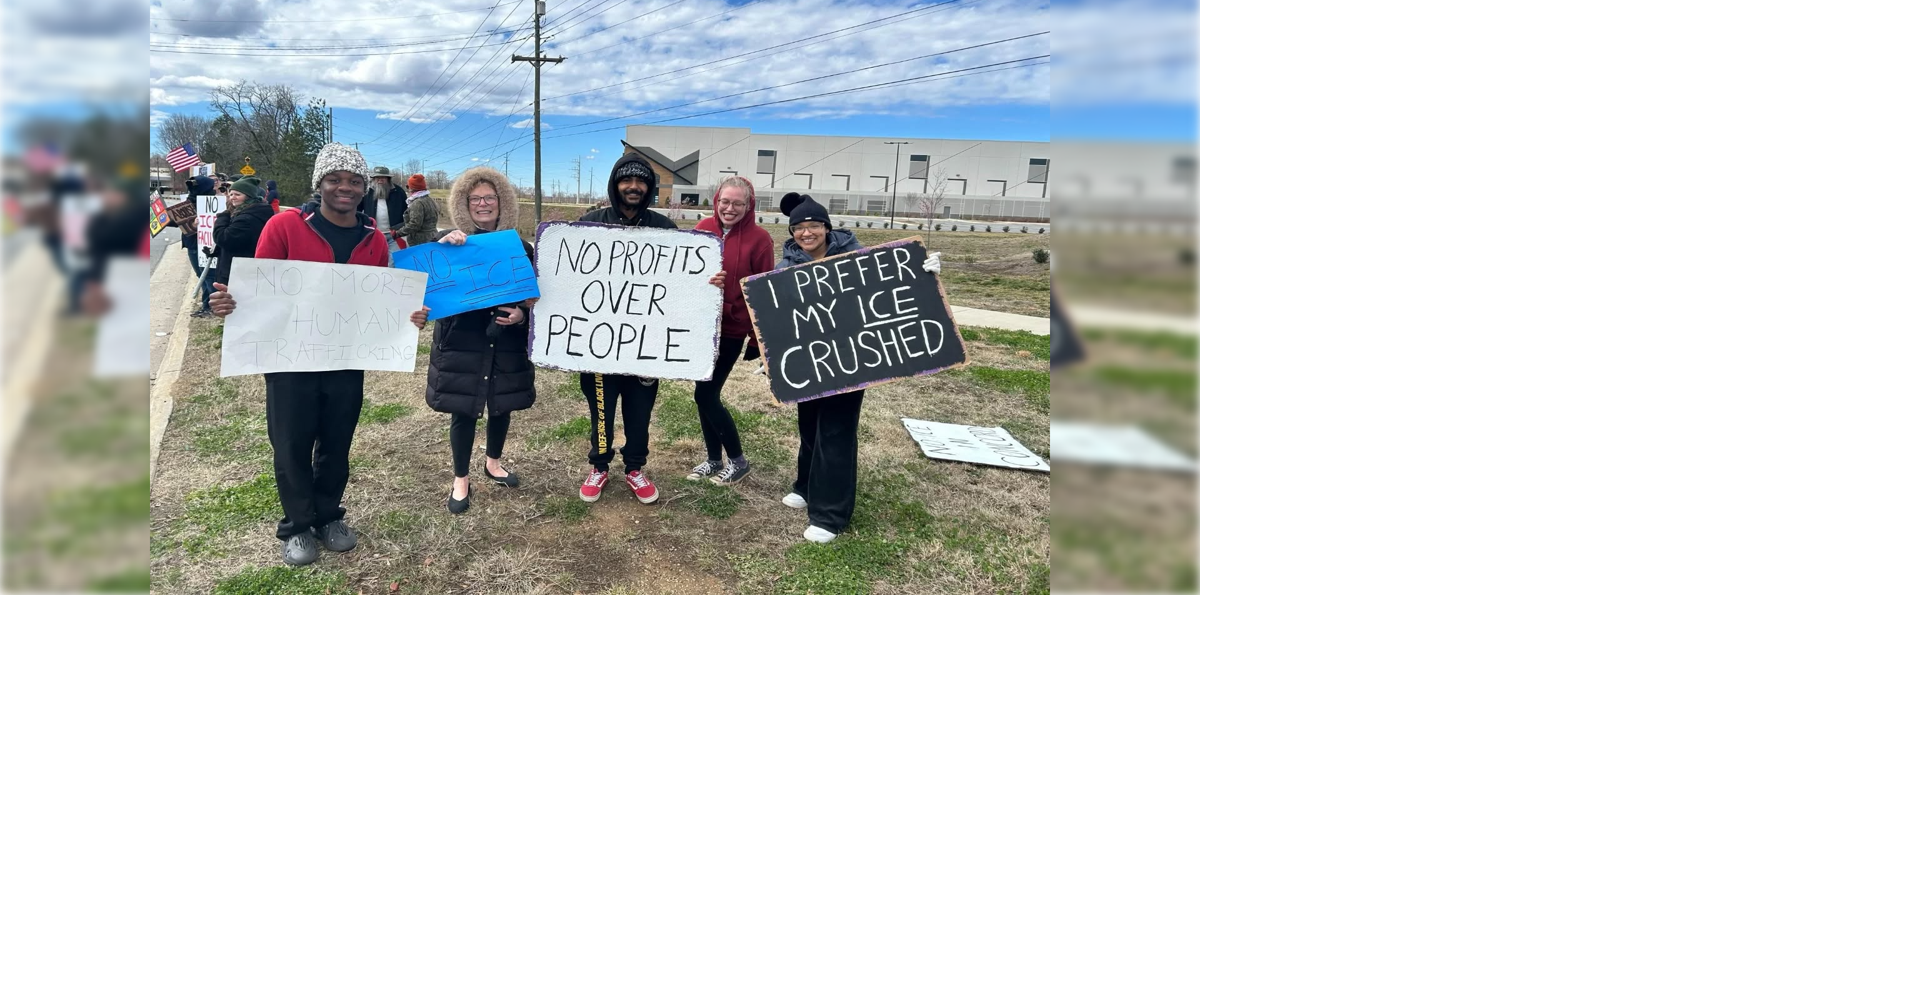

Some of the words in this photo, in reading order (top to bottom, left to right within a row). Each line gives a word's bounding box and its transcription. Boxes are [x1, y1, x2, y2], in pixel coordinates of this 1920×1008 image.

[206, 196, 218, 213] NO
[412, 249, 452, 283] NO
[459, 254, 534, 295] ICE
[555, 237, 601, 276] NO
[608, 240, 710, 276] PROFITS
[255, 266, 303, 297] NO
[331, 267, 414, 297] MORE
[767, 279, 779, 308] I
[794, 247, 916, 303] PREFER
[581, 279, 667, 316] OVER
[792, 298, 837, 339] MY
[857, 285, 919, 324] ICE
[292, 304, 401, 337] HUMAN
[545, 314, 690, 362] PEOPLE
[241, 338, 415, 367] TRAFFICKING
[780, 319, 944, 389] CRUSHED
[596, 387, 605, 410] BLACK
[598, 410, 605, 419] OF
[597, 420, 607, 447] DEFENSE
